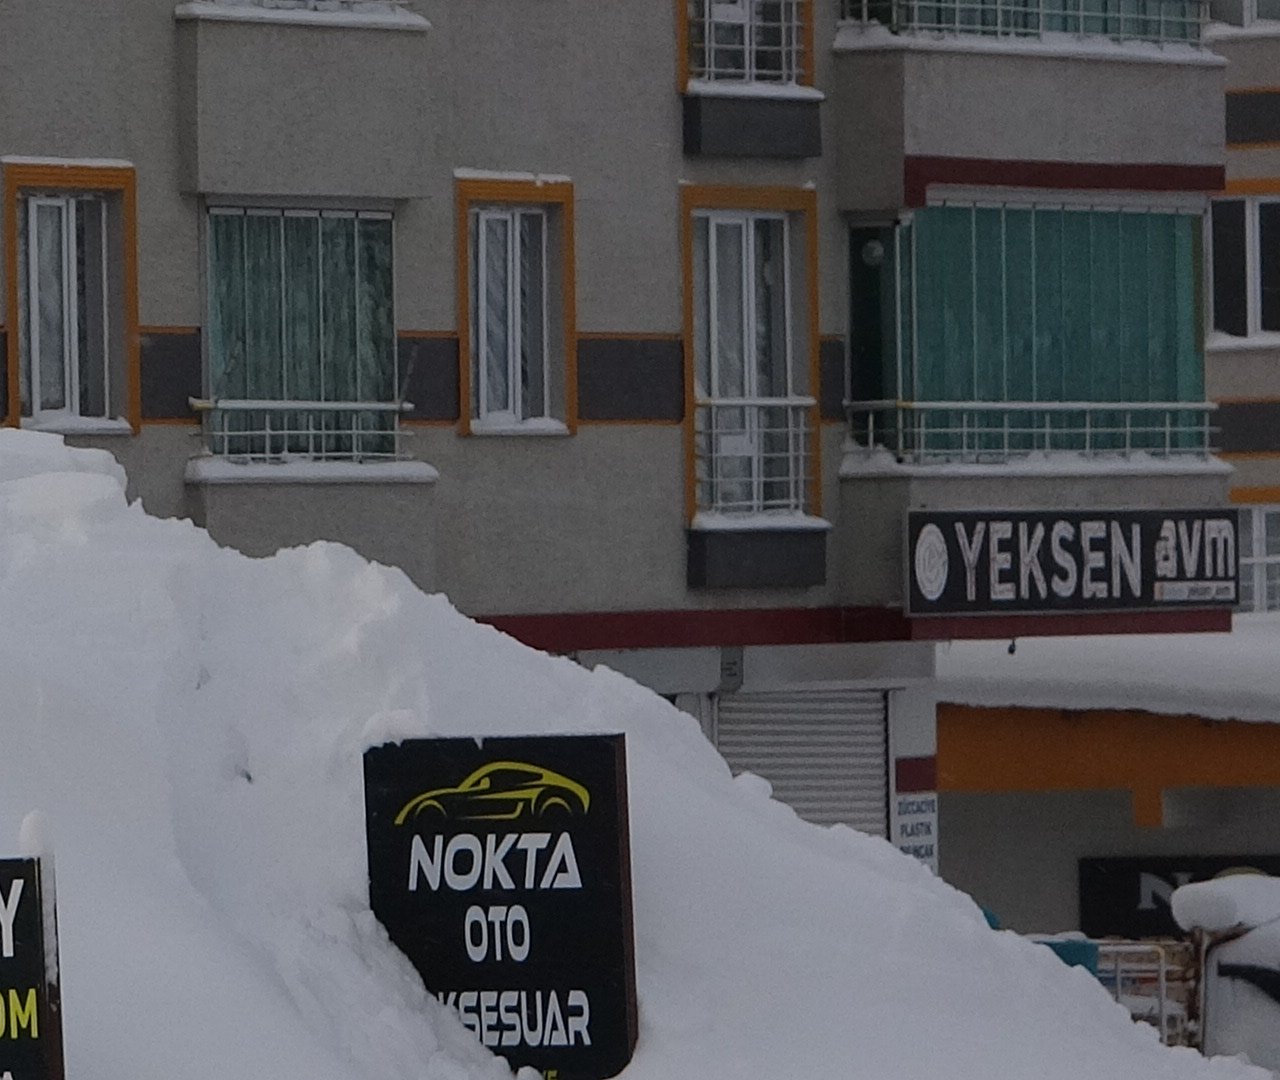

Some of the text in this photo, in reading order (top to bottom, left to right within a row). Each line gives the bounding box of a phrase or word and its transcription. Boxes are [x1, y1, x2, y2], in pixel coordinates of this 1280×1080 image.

[954, 518, 1237, 601] YEKSEN avm
[408, 831, 583, 891] NOKTA
[464, 904, 531, 962] OTO
